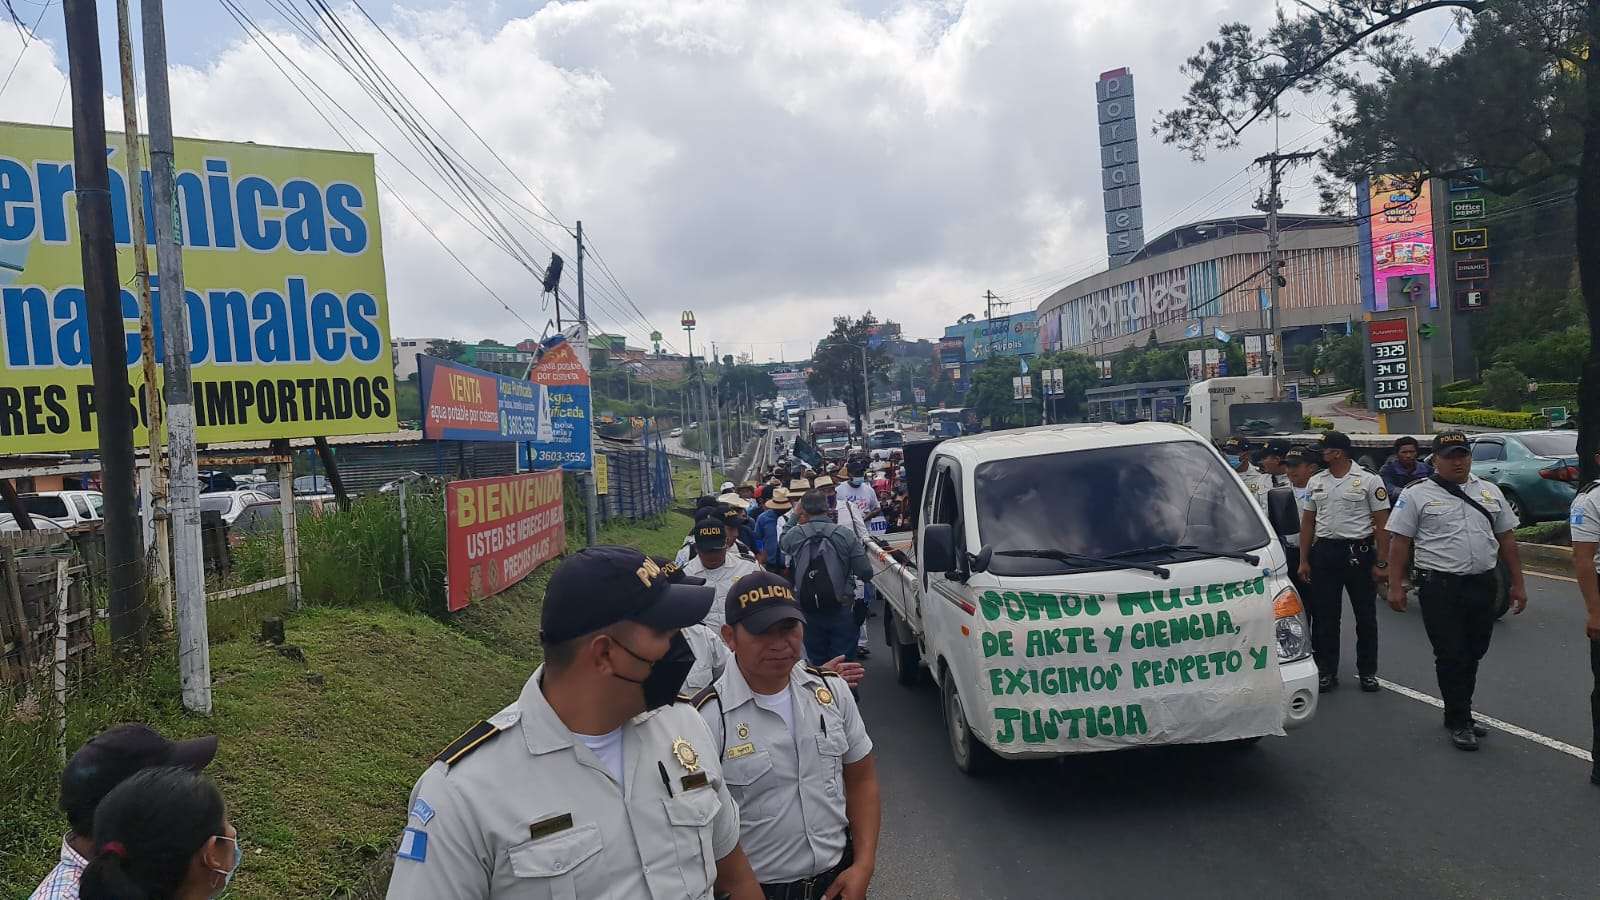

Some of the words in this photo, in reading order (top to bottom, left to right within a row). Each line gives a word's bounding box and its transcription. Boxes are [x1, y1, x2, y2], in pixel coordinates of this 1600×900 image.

[1106, 79, 1130, 249] portales
[1086, 277, 1188, 338] portales
[1376, 345, 1405, 357] 33.29
[537, 373, 550, 382] por
[1377, 363, 1406, 375] 34.19
[192, 376, 392, 427] IMPORTADOS
[449, 373, 482, 404] VENTA
[1378, 380, 1407, 392] 31.19
[1379, 397, 1408, 409] 00.00
[538, 450, 586, 462] 3603-3552
[456, 472, 562, 528] BIENVENIDO
[466, 527, 504, 559] USTED
[738, 585, 795, 609] POLICIA
[979, 590, 1106, 622] SOMOS
[981, 630, 1014, 657] DE
[1025, 626, 1098, 657] ARTE
[1103, 625, 1124, 653] Y
[1130, 610, 1241, 650] CIENCIA,
[988, 662, 1123, 696] EXIGIMOS
[1132, 649, 1243, 689] RESPETO
[1249, 645, 1269, 670] Y
[994, 703, 1148, 744] JUSTICIA
